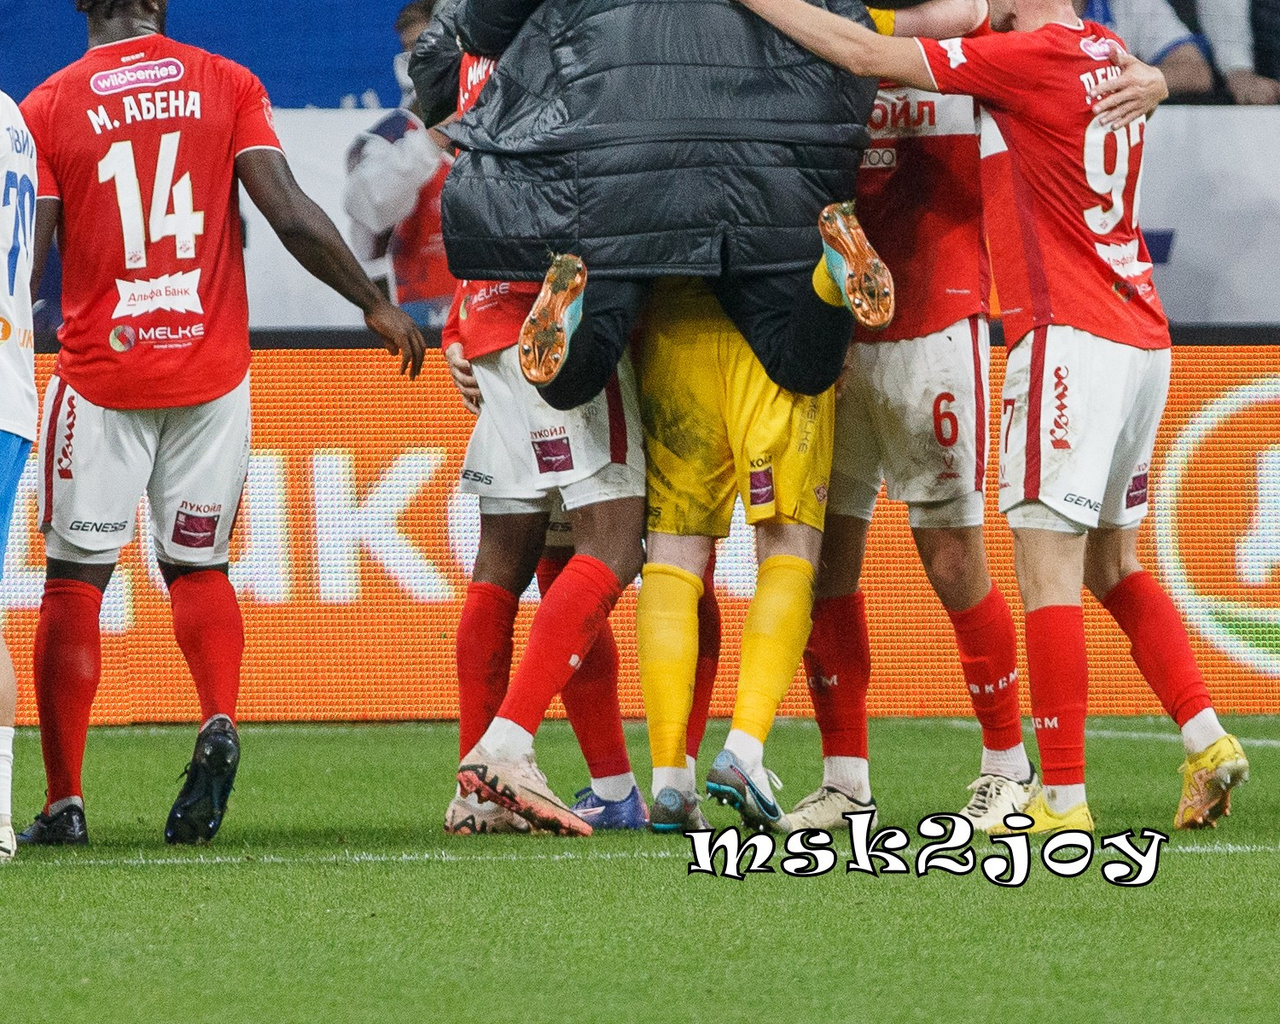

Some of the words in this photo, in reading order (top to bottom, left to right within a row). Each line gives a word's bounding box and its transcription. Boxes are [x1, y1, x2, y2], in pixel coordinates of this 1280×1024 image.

[97, 63, 177, 89] wildberries
[86, 105, 120, 135] М.
[122, 90, 201, 124] АБЕНА
[868, 96, 936, 131] ОЙЛ
[97, 130, 205, 270] 14
[127, 289, 162, 303] Альфа
[164, 285, 191, 296] Банк
[138, 323, 205, 341] MELKE
[933, 392, 959, 448] 6
[1003, 398, 1016, 454] 7
[462, 469, 494, 485] ESIS
[1064, 493, 1102, 513] GENE
